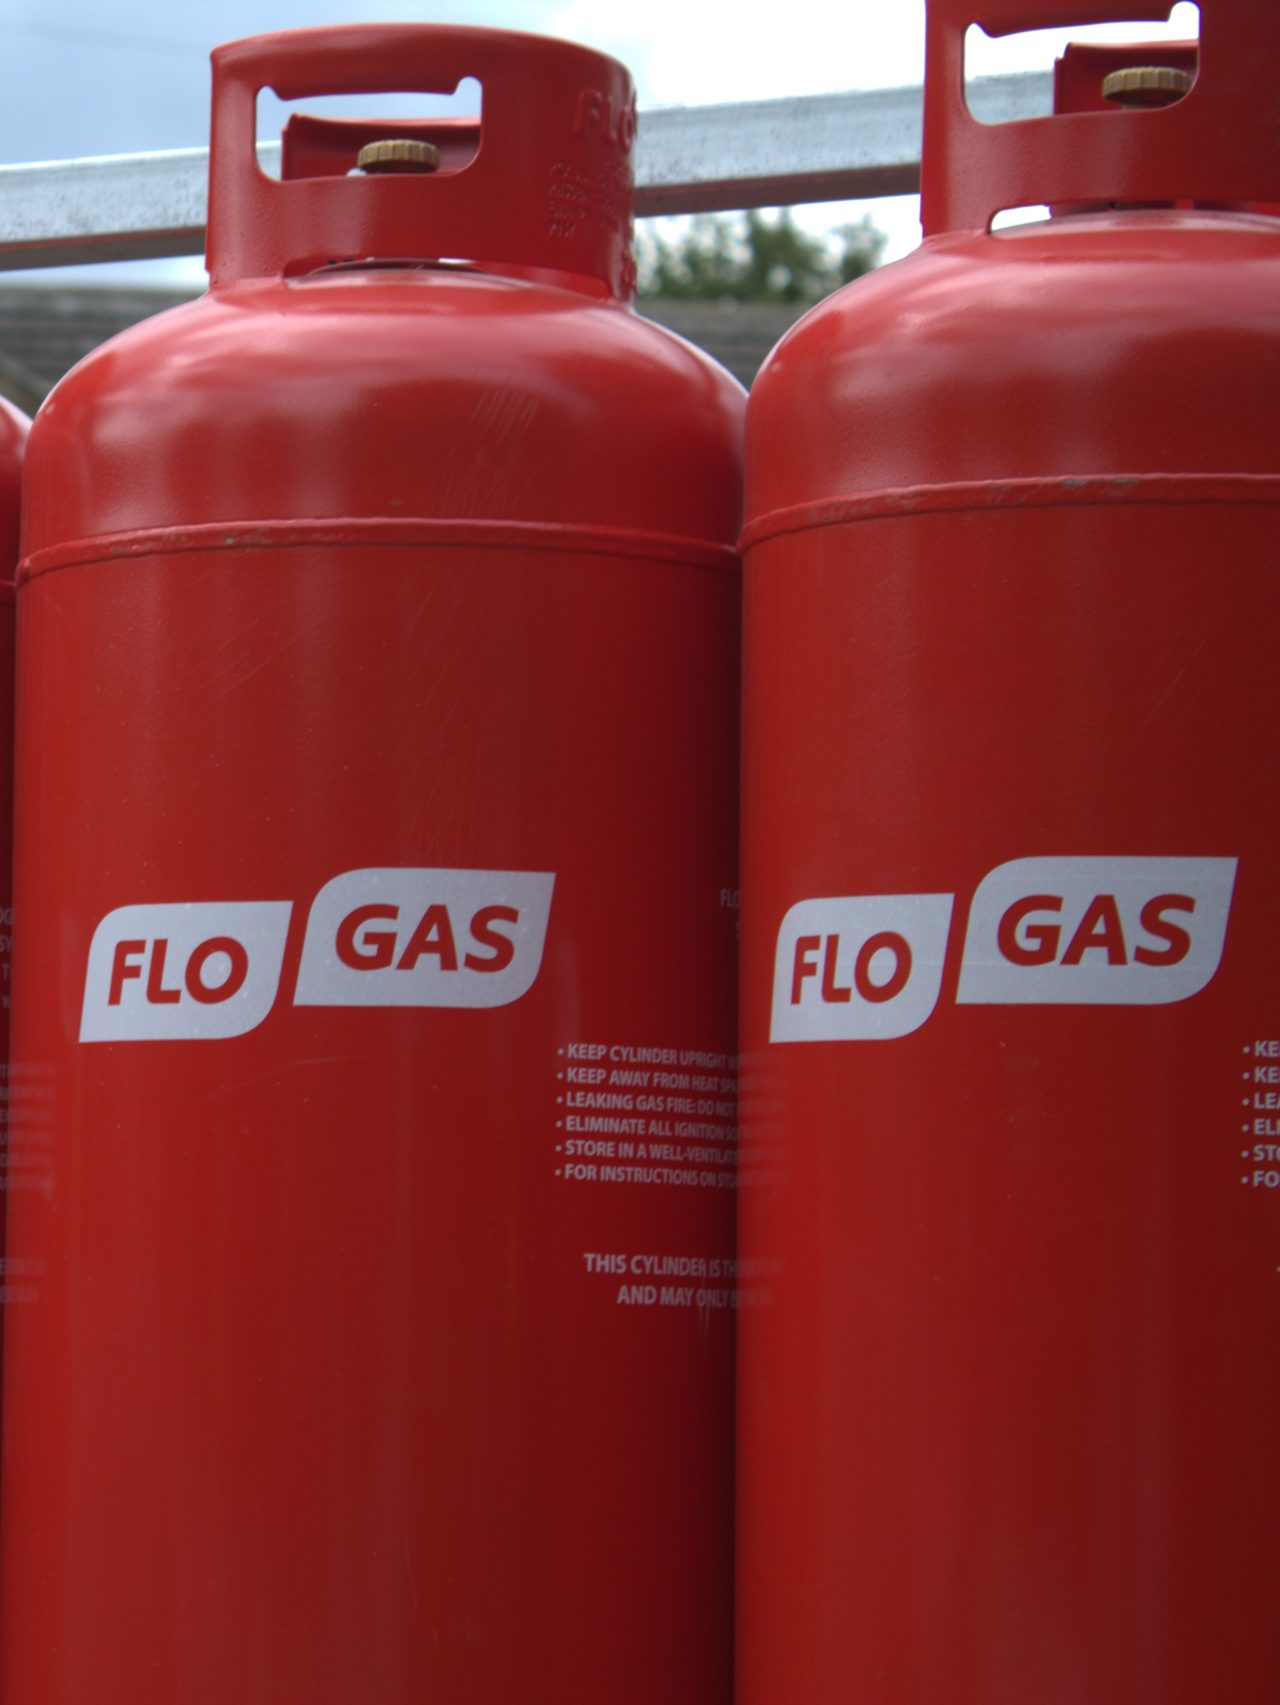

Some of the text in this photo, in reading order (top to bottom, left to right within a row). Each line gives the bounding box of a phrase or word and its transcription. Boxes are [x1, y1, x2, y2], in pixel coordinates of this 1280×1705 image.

[108, 903, 519, 1006] FLO GAS
[791, 894, 1196, 1005] FLO GAS
[567, 1043, 607, 1061] KEEP
[609, 1044, 678, 1065] CYLINDER
[567, 1067, 607, 1085] KEEP
[608, 1068, 651, 1087] AWAY
[652, 1071, 690, 1090] FROM
[691, 1074, 719, 1092] HEAT
[566, 1091, 634, 1111] LEAKING
[635, 1094, 665, 1112] GAS
[697, 1098, 714, 1116] DO
[566, 1115, 646, 1136] ELIMINATE
[648, 1119, 673, 1137] ALL
[674, 1121, 724, 1141] IGNITION
[566, 1139, 616, 1159] STORE
[618, 1141, 635, 1159] IN
[636, 1142, 648, 1160] A
[564, 1163, 598, 1181] FOR
[600, 1165, 699, 1186] INSTRUCTIONS
[700, 1170, 717, 1187] ON
[583, 1252, 627, 1275] THIS
[630, 1253, 707, 1278] CYLINDER
[709, 1258, 721, 1278] IS
[616, 1284, 658, 1306] AND
[659, 1286, 695, 1307] MAY
